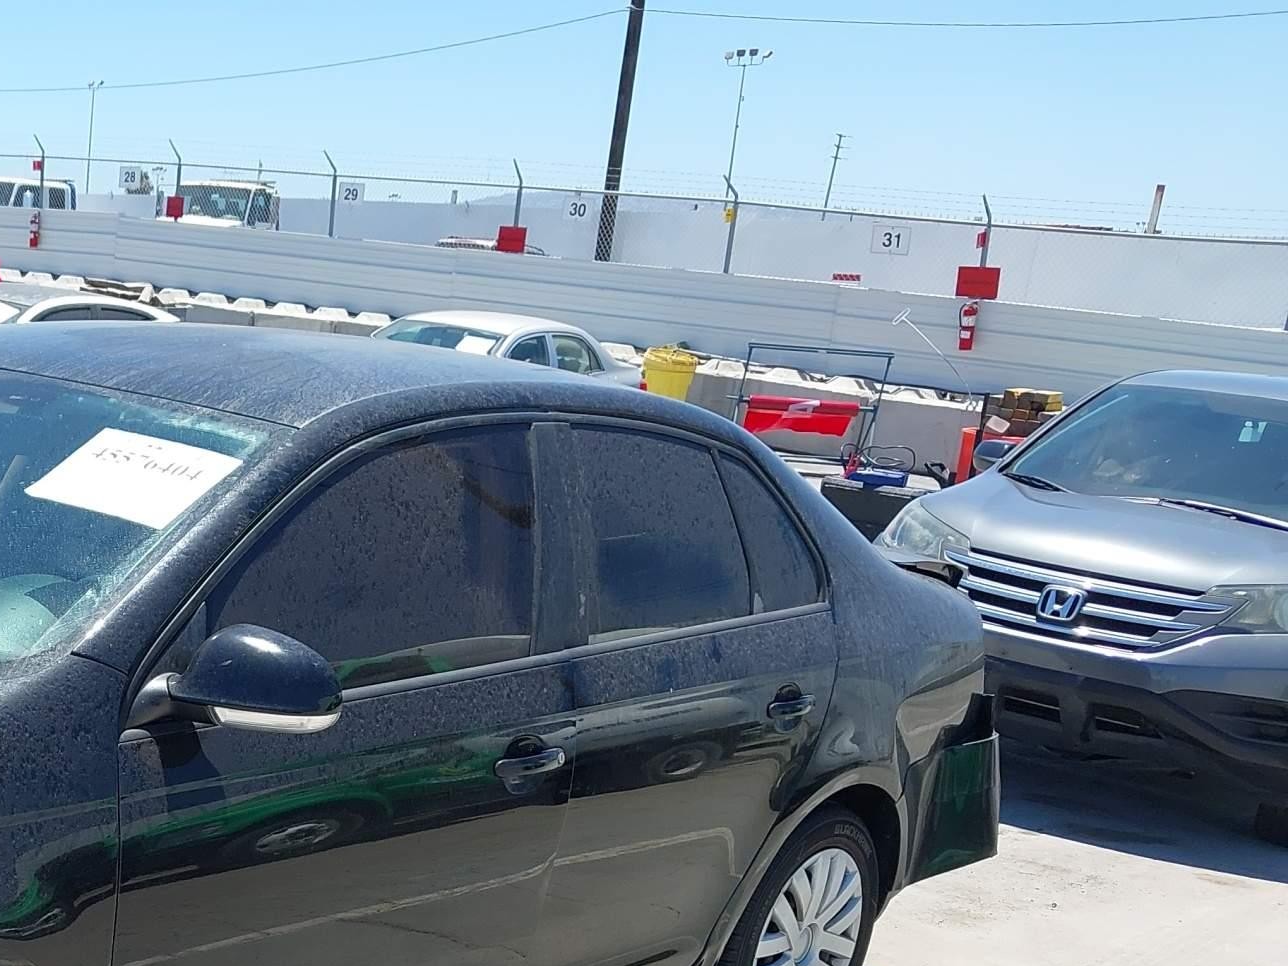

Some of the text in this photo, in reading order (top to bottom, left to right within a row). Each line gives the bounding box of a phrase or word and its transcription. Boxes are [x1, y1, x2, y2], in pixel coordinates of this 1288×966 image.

[124, 171, 136, 183] 28
[344, 188, 358, 201] 29
[569, 202, 587, 217] 30
[881, 232, 901, 249] 31
